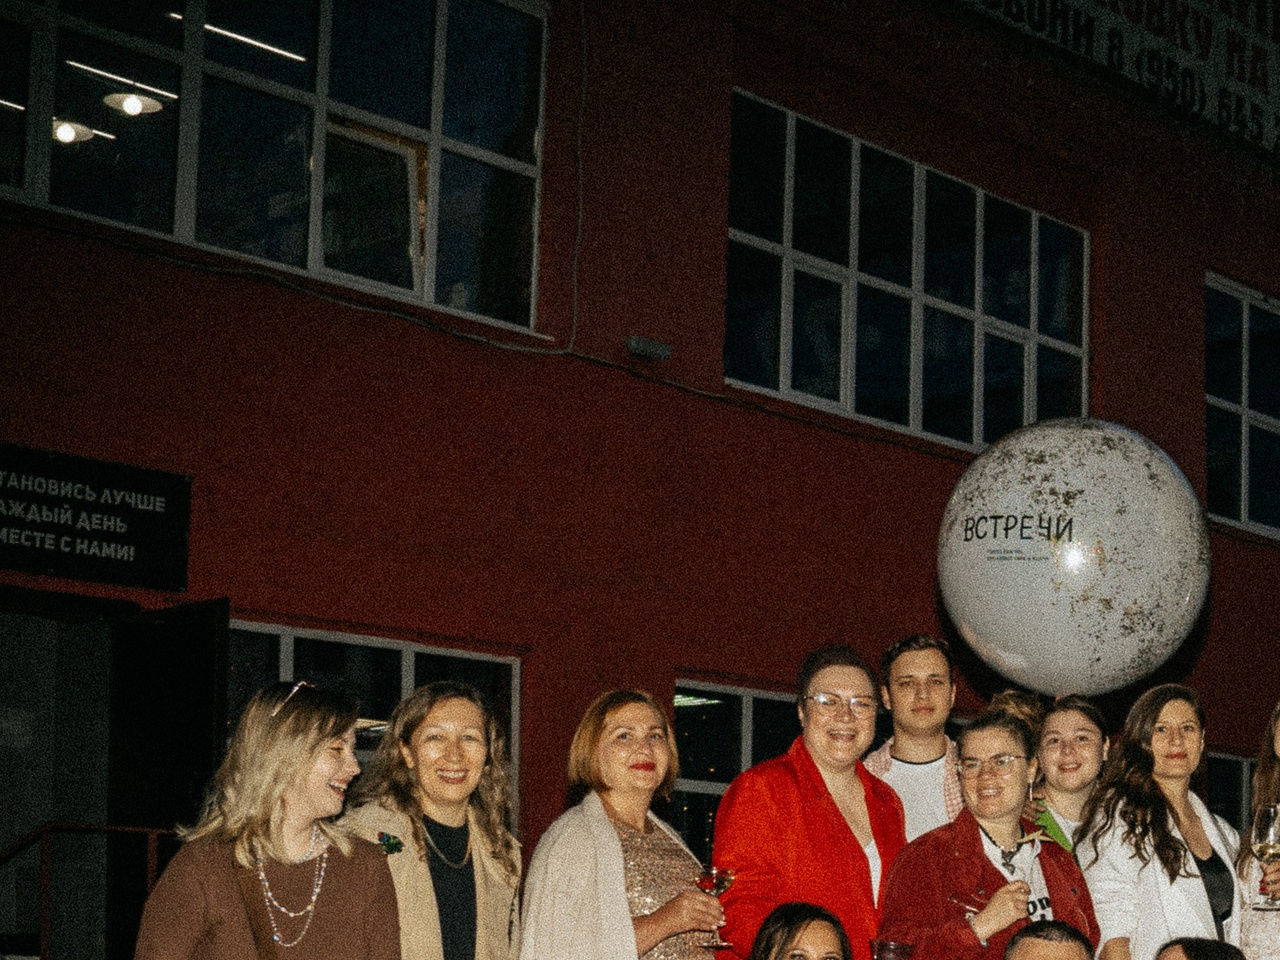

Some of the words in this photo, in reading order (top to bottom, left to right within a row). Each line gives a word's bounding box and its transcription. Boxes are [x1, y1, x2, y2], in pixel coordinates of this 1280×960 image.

[99, 488, 167, 513] ЛУЧШЕ
[75, 511, 128, 534] ДЕНЬ
[963, 514, 1074, 542] ВСТРЕЧИ
[59, 536, 72, 553] С
[75, 537, 135, 562] НАМИ!
